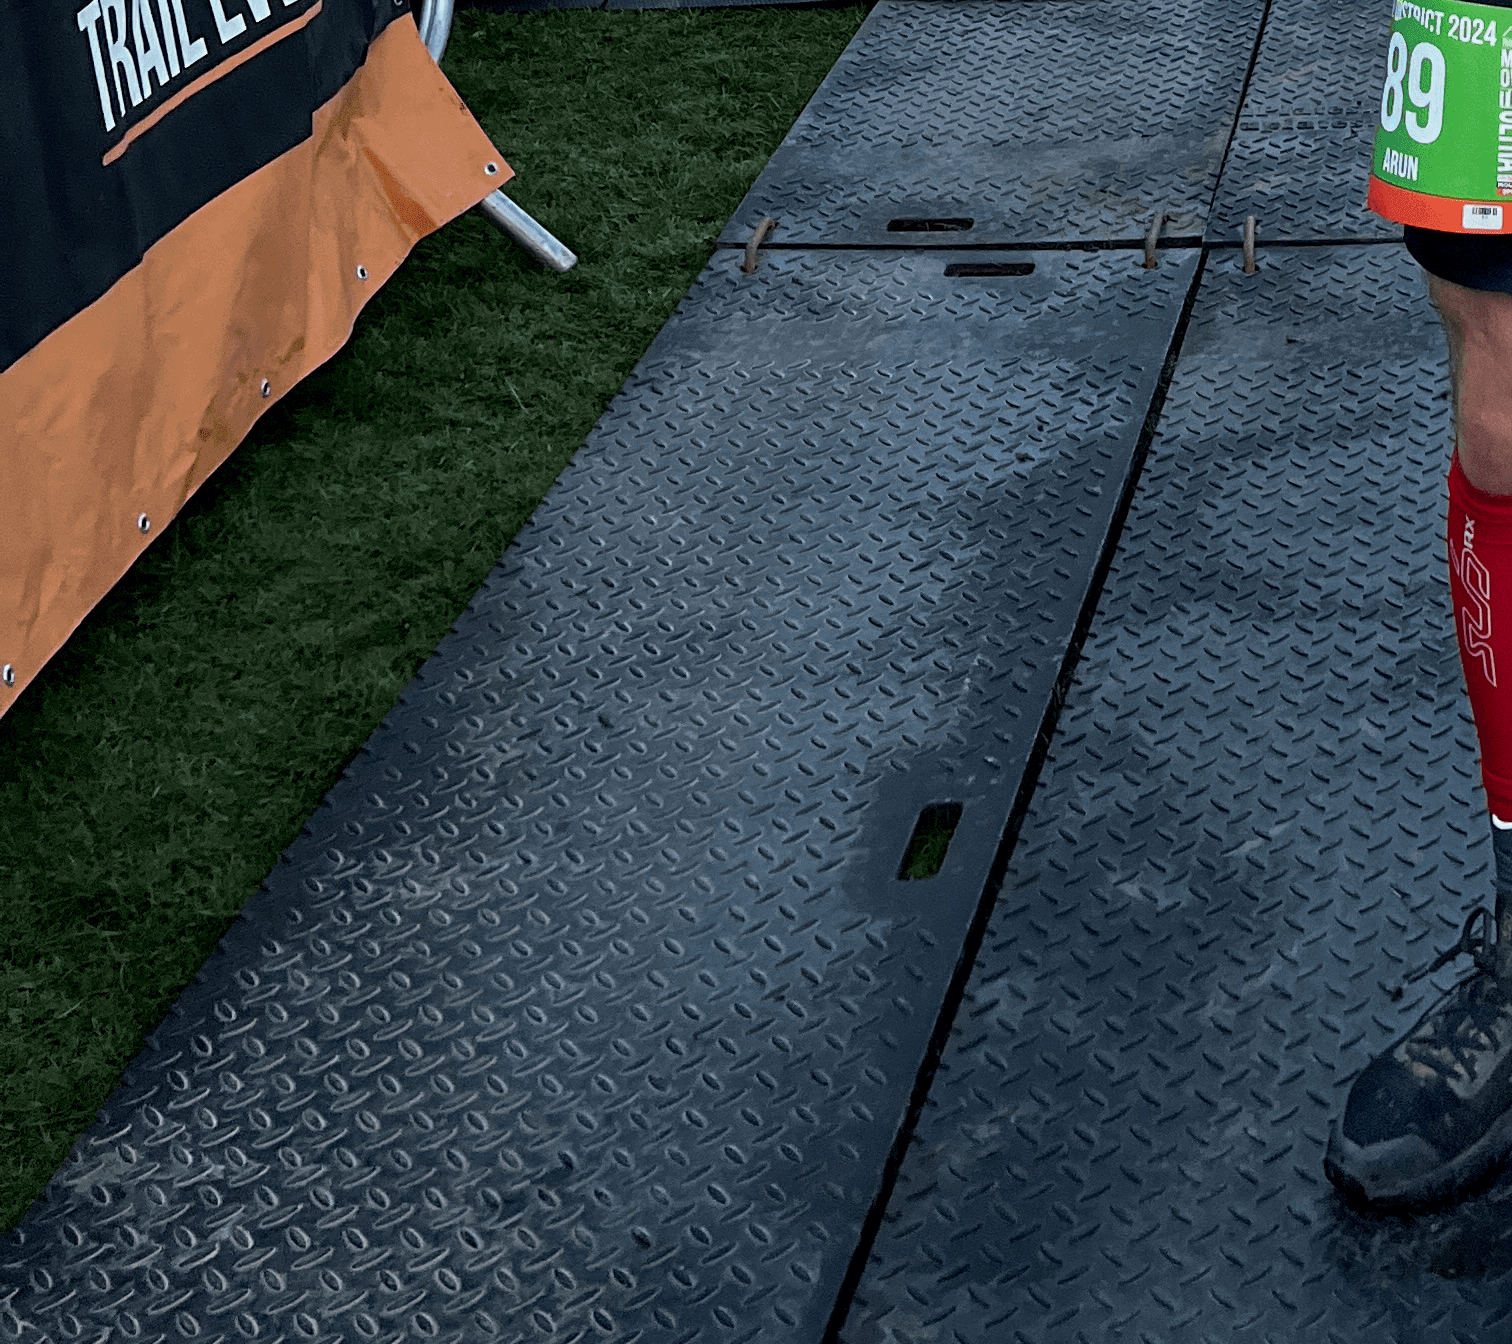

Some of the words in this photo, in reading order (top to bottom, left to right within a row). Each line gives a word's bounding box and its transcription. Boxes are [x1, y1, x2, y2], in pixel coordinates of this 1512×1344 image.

[1447, 13, 1497, 46] 2024
[1381, 31, 1446, 144] 89
[1383, 147, 1418, 181] ARUN
